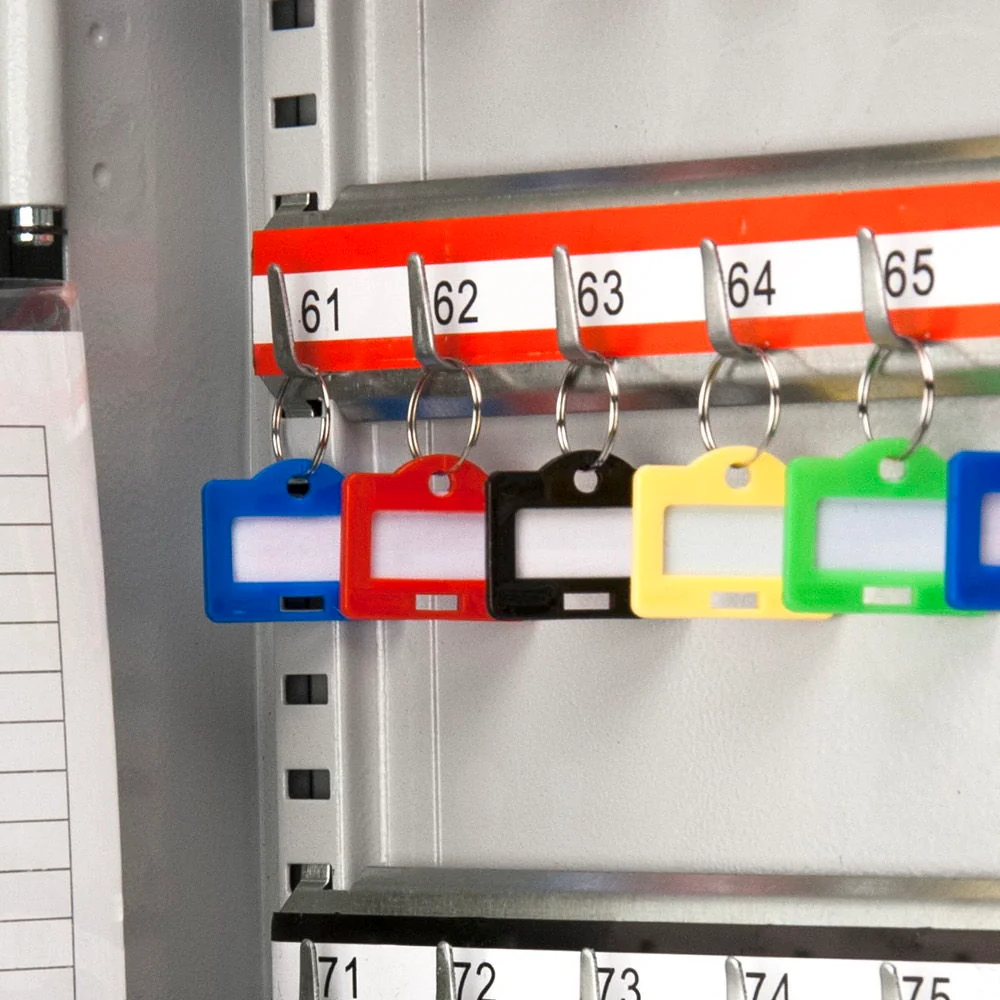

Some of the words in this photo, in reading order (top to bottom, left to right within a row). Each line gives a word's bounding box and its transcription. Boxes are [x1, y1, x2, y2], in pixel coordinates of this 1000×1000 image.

[577, 269, 624, 318] 63
[728, 260, 777, 309] 64
[884, 248, 935, 298] 65
[301, 287, 341, 333] 61
[433, 279, 478, 326] 62
[318, 956, 358, 999] 71
